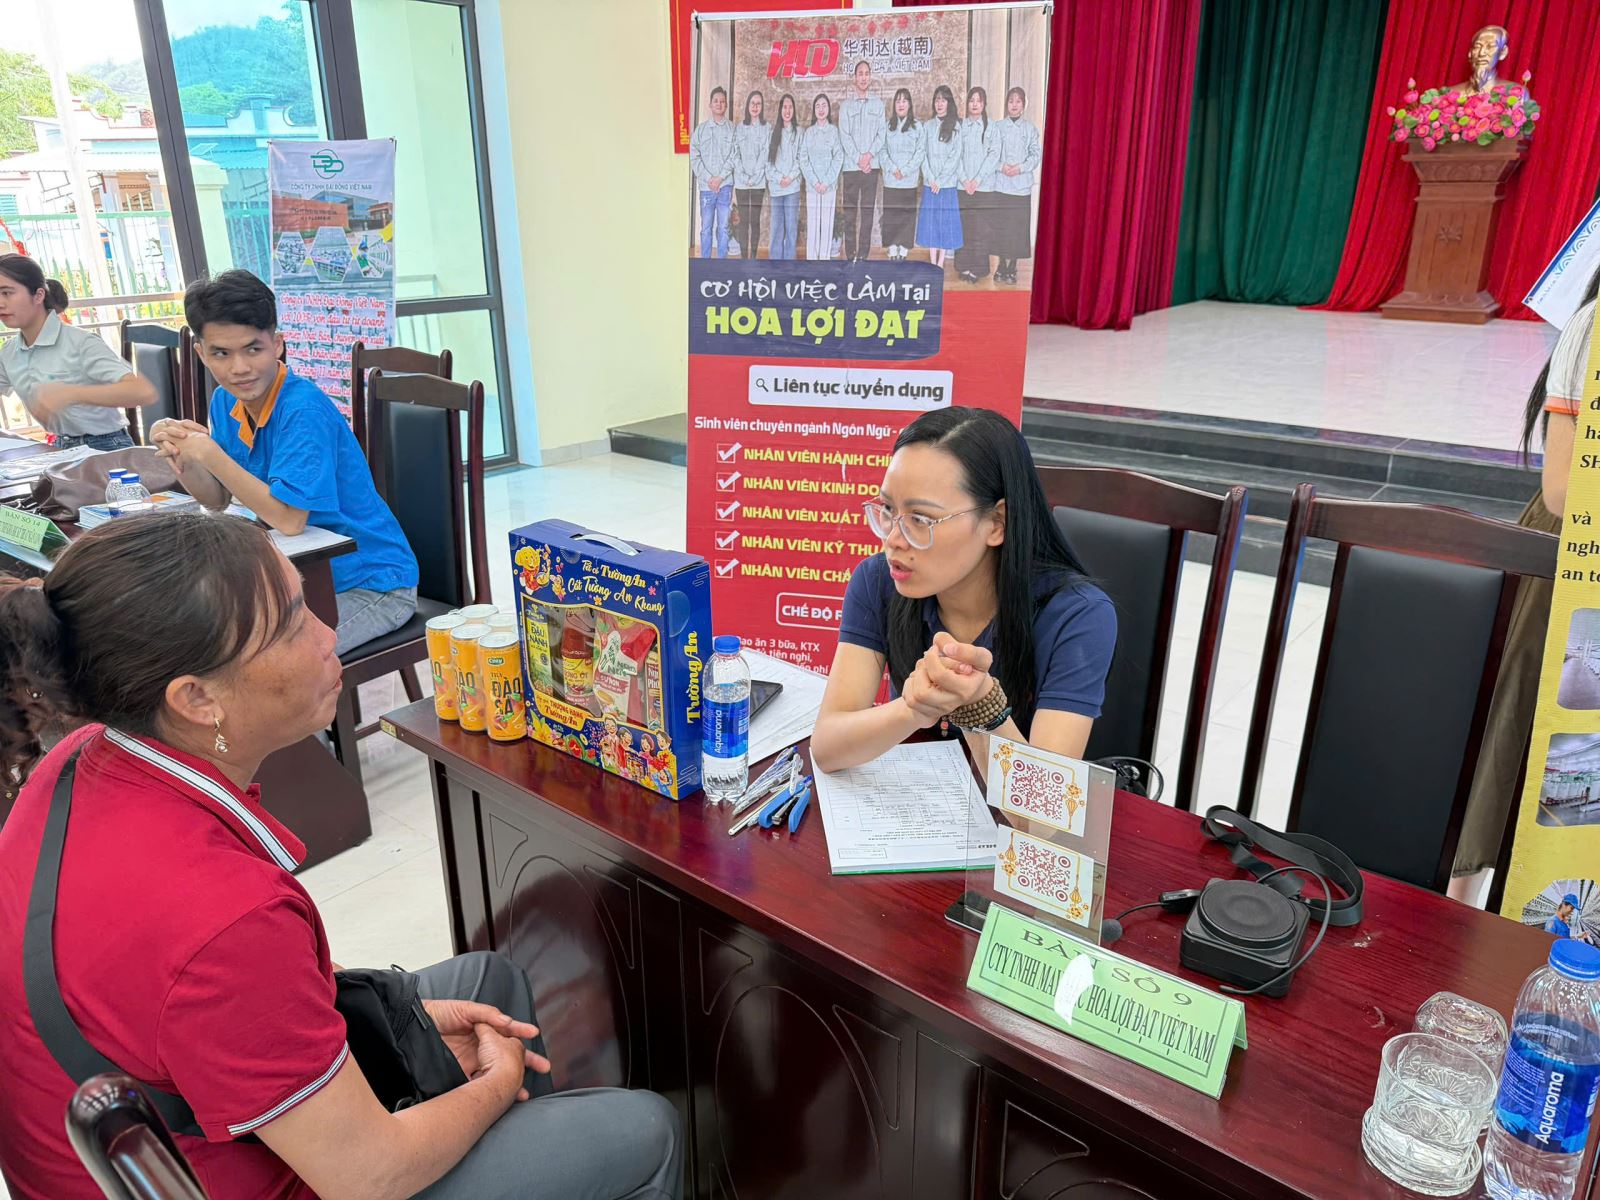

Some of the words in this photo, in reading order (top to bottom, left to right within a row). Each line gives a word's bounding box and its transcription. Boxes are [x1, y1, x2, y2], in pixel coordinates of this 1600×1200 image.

[844, 36, 933, 57] 华利达(越南)
[700, 278, 732, 298] CƠ
[738, 276, 776, 302] HỘI
[786, 279, 838, 303] VIỆC
[847, 275, 896, 302] LÀM
[901, 283, 930, 305] Tại
[706, 306, 783, 336] HOA
[791, 306, 845, 345] LỢI
[855, 309, 926, 347] ĐẠT
[774, 377, 810, 394] Liên
[813, 380, 840, 398] tục
[844, 377, 895, 400] tuyển
[898, 381, 944, 401] dụng
[694, 416, 722, 430] Sinh
[723, 417, 749, 430] viên
[750, 418, 793, 435] chuyên
[794, 421, 831, 437] ngành
[832, 421, 865, 439] Ngôn
[866, 423, 891, 440] Ngữ
[744, 448, 785, 463] NHÂN
[787, 449, 820, 464] VIÊN
[823, 449, 863, 466] HÀNH
[743, 476, 784, 491] NHÂN
[786, 478, 819, 493] VIÊN
[821, 482, 855, 494] KINH
[857, 484, 880, 496] DO
[742, 505, 782, 520] NHÂN
[785, 507, 818, 523] VIÊN
[1571, 510, 1592, 526] và
[742, 535, 783, 550] NHÂN
[786, 537, 821, 553] VIÊN
[824, 540, 845, 554] KỸ
[741, 563, 783, 578] NHÂN
[785, 566, 820, 581] VIÊN
[822, 569, 852, 583] CHẤ
[1561, 568, 1584, 581] an
[614, 587, 633, 605] An
[634, 595, 665, 617] Khang
[782, 602, 809, 618] CHẾ
[811, 607, 833, 622] ĐỘ
[755, 637, 767, 647] ăn
[769, 639, 776, 648] 3
[778, 638, 799, 650] bữa,
[800, 641, 820, 652] KTX
[491, 677, 521, 698] ĐÀO
[714, 709, 724, 753] Aquaroma
[1111, 966, 1162, 995] SỐ
[1174, 992, 1193, 1007] 9
[988, 942, 1013, 975] CTY
[1011, 953, 1042, 988] TNHH
[1085, 983, 1112, 1021] HOA
[1110, 994, 1137, 1035] LỢI
[1132, 1002, 1161, 1044] ĐẠT
[1157, 1013, 1187, 1056] VIỆT
[1186, 1024, 1216, 1064] NAM
[1534, 1071, 1565, 1144] Aquaroma
